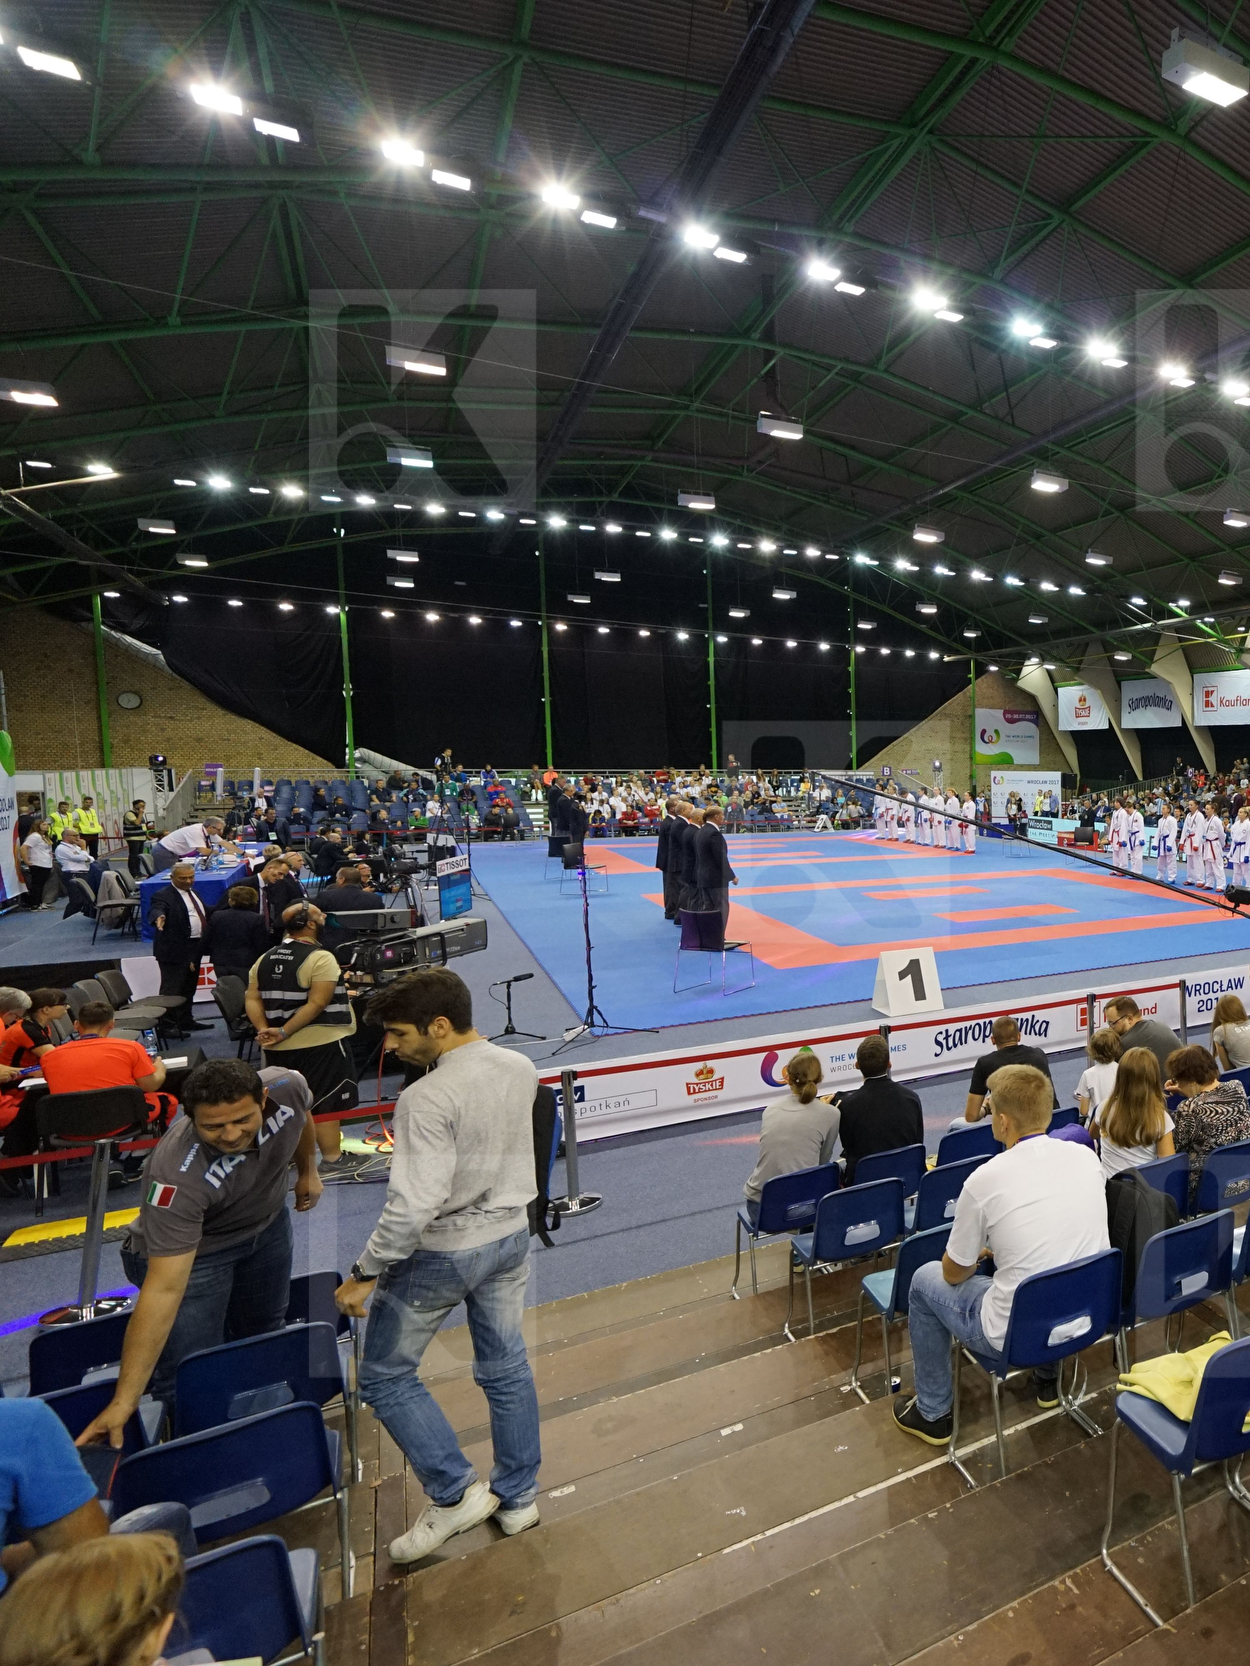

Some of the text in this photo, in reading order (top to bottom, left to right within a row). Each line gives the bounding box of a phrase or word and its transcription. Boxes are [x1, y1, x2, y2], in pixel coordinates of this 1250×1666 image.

[1127, 692, 1174, 714] Staropolanka
[883, 767, 890, 776] B
[445, 858, 468, 872] TISSOT
[897, 958, 927, 1002] 1
[1197, 997, 1219, 1013] 201
[934, 1014, 1050, 1058] Staropnka
[830, 1054, 846, 1063] THE
[889, 1043, 907, 1054] MES
[688, 1079, 722, 1094] TYSKIE
[693, 1095, 719, 1104] SPONSOR
[179, 1142, 200, 1173] Kappa
